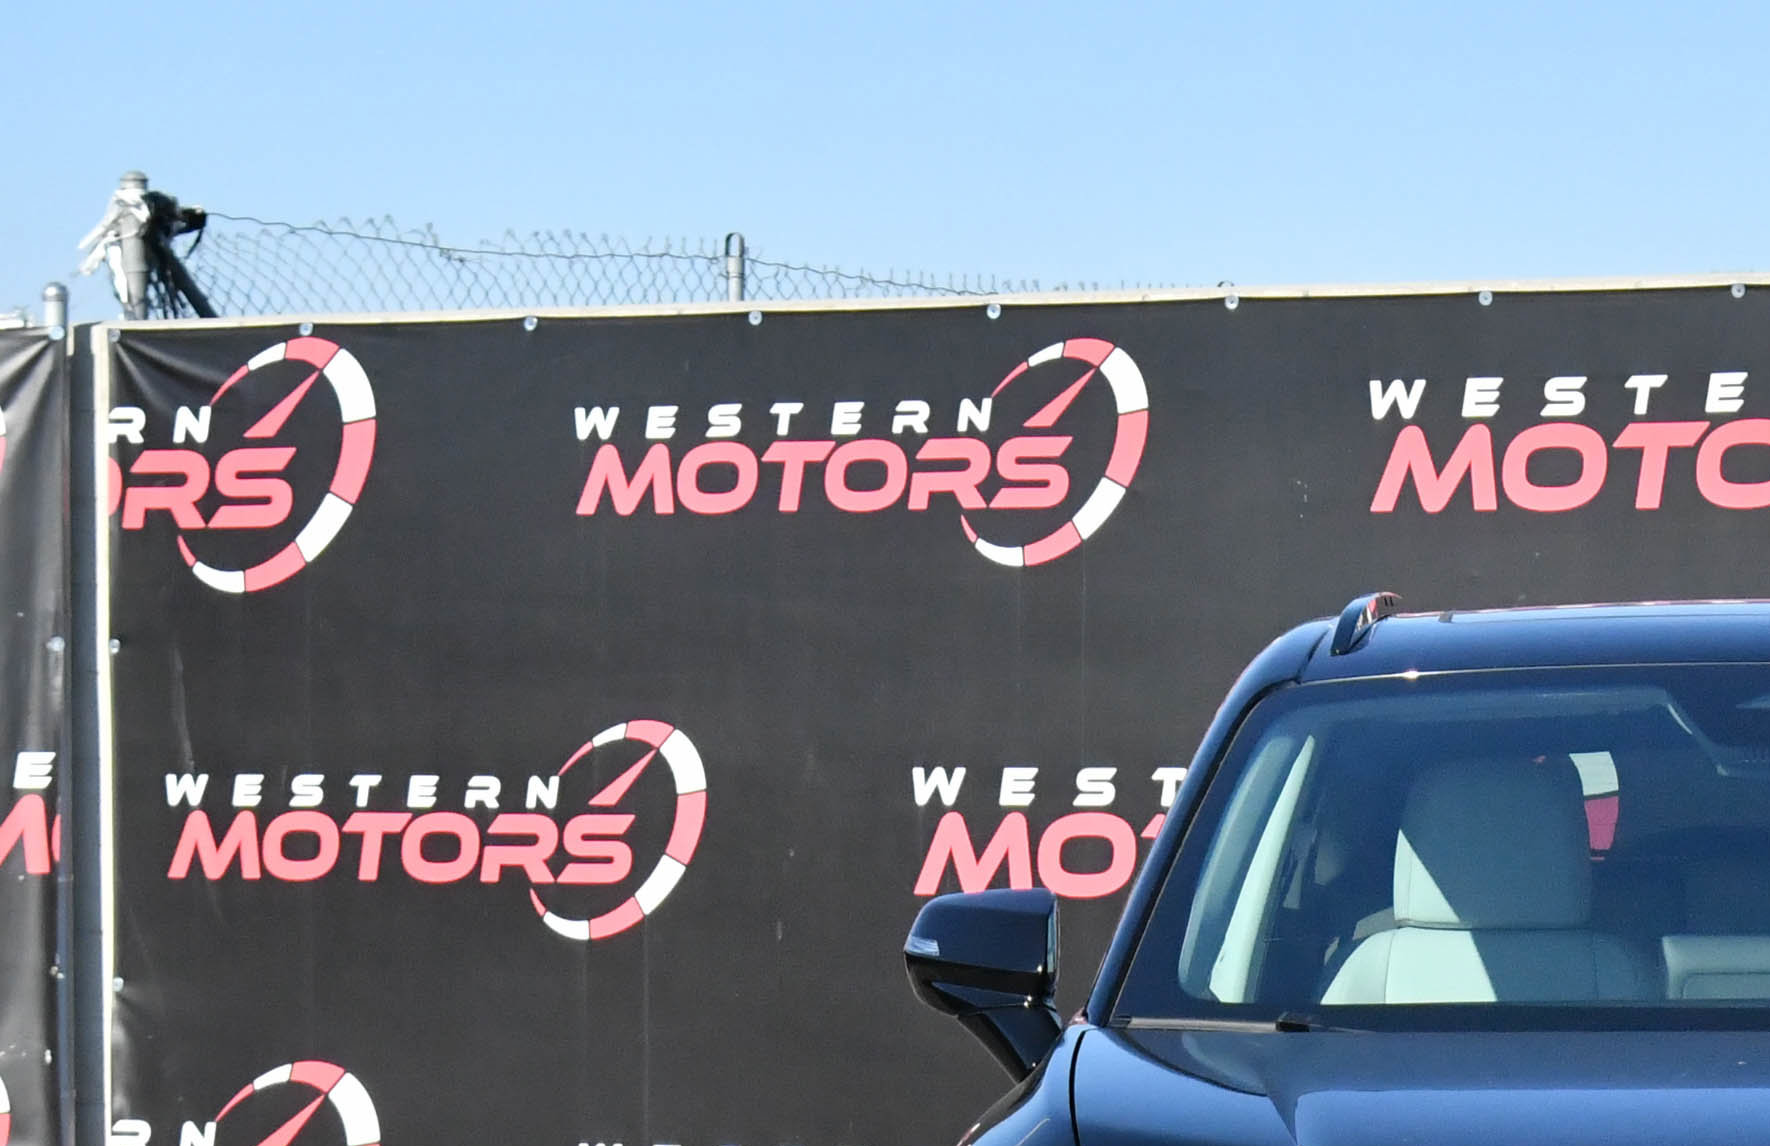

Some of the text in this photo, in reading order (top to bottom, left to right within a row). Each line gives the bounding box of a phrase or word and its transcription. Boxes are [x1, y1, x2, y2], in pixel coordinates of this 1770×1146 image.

[575, 398, 993, 440] WESTERN
[109, 447, 297, 531] RS
[576, 436, 1074, 515] MOTORS
[166, 774, 560, 808] WESTERN
[913, 767, 1187, 807] WEST
[168, 810, 636, 885] MOTORS
[914, 811, 1166, 899] MO
